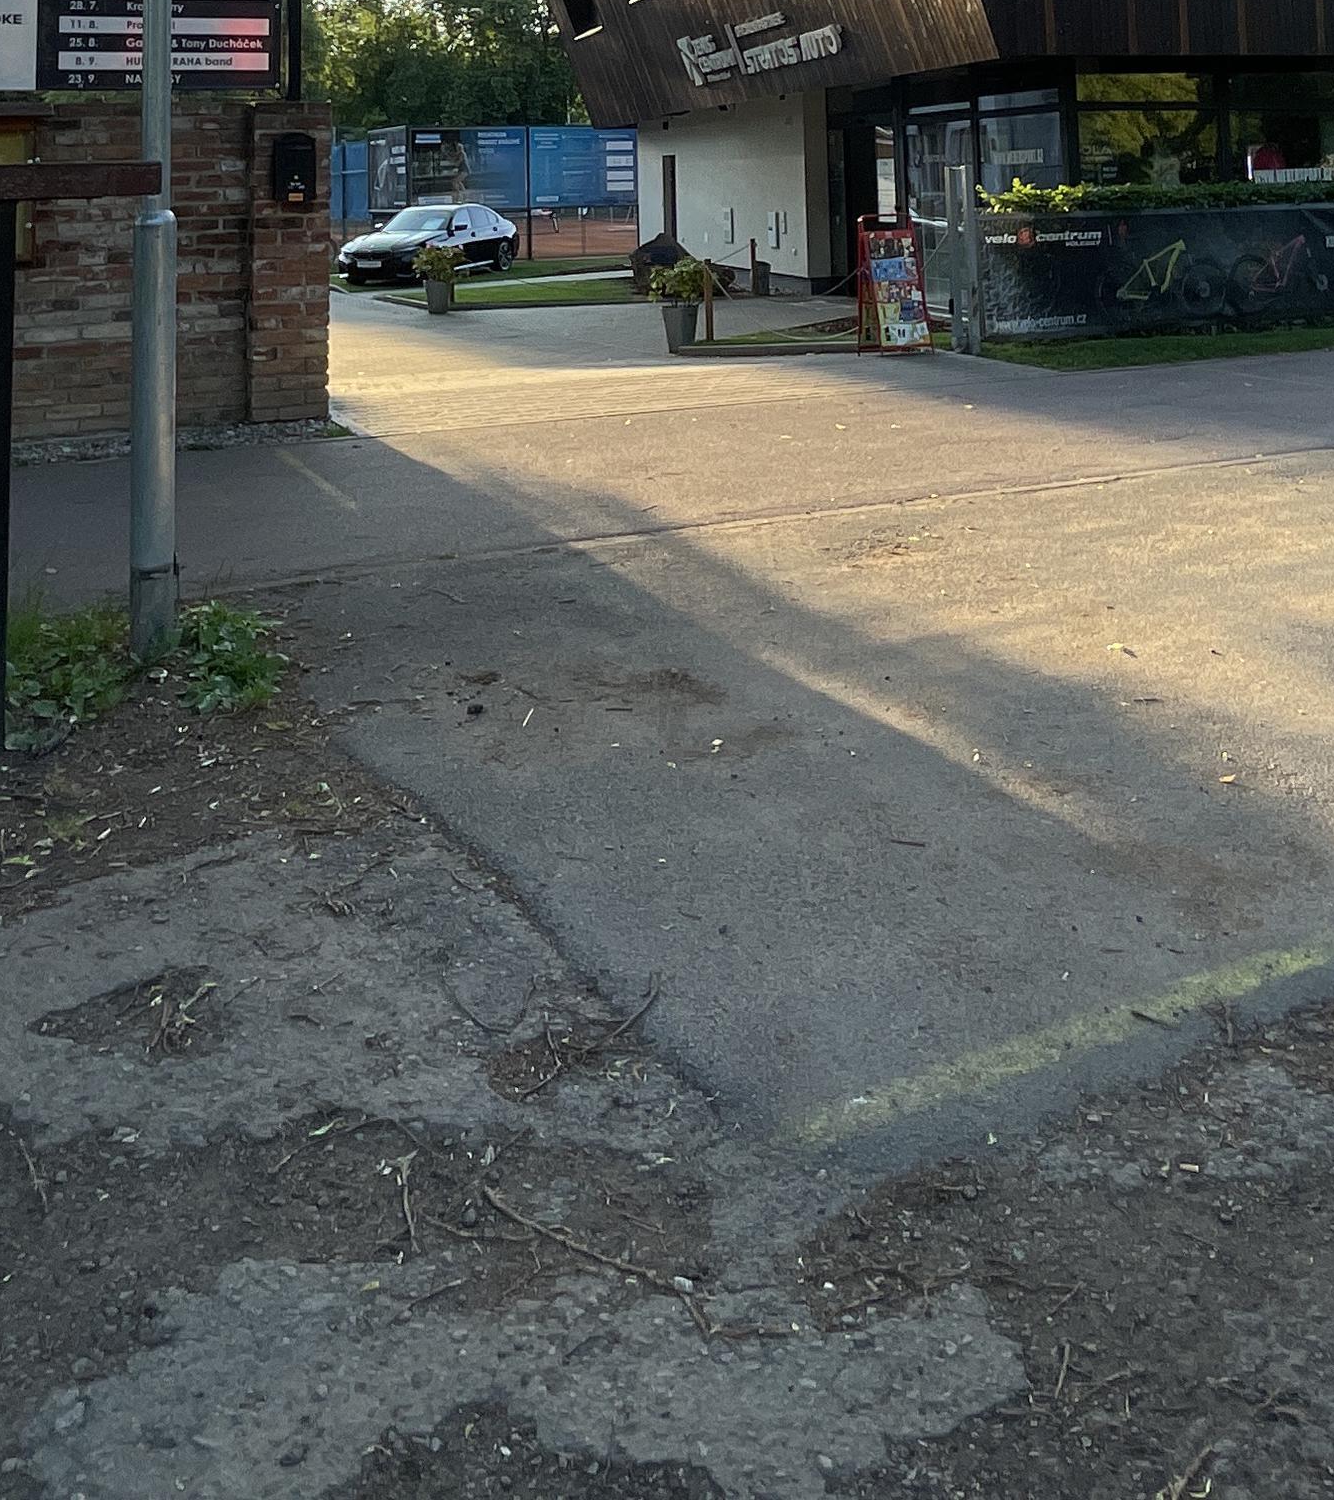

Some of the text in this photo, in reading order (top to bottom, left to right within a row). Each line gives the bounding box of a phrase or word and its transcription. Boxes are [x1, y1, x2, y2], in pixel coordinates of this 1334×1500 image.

[181, 39, 205, 51] Tony
[209, 36, 263, 49] Ducháček
[172, 57, 202, 66] RAHA
[205, 56, 233, 66] band
[984, 230, 1103, 245] velo centrum
